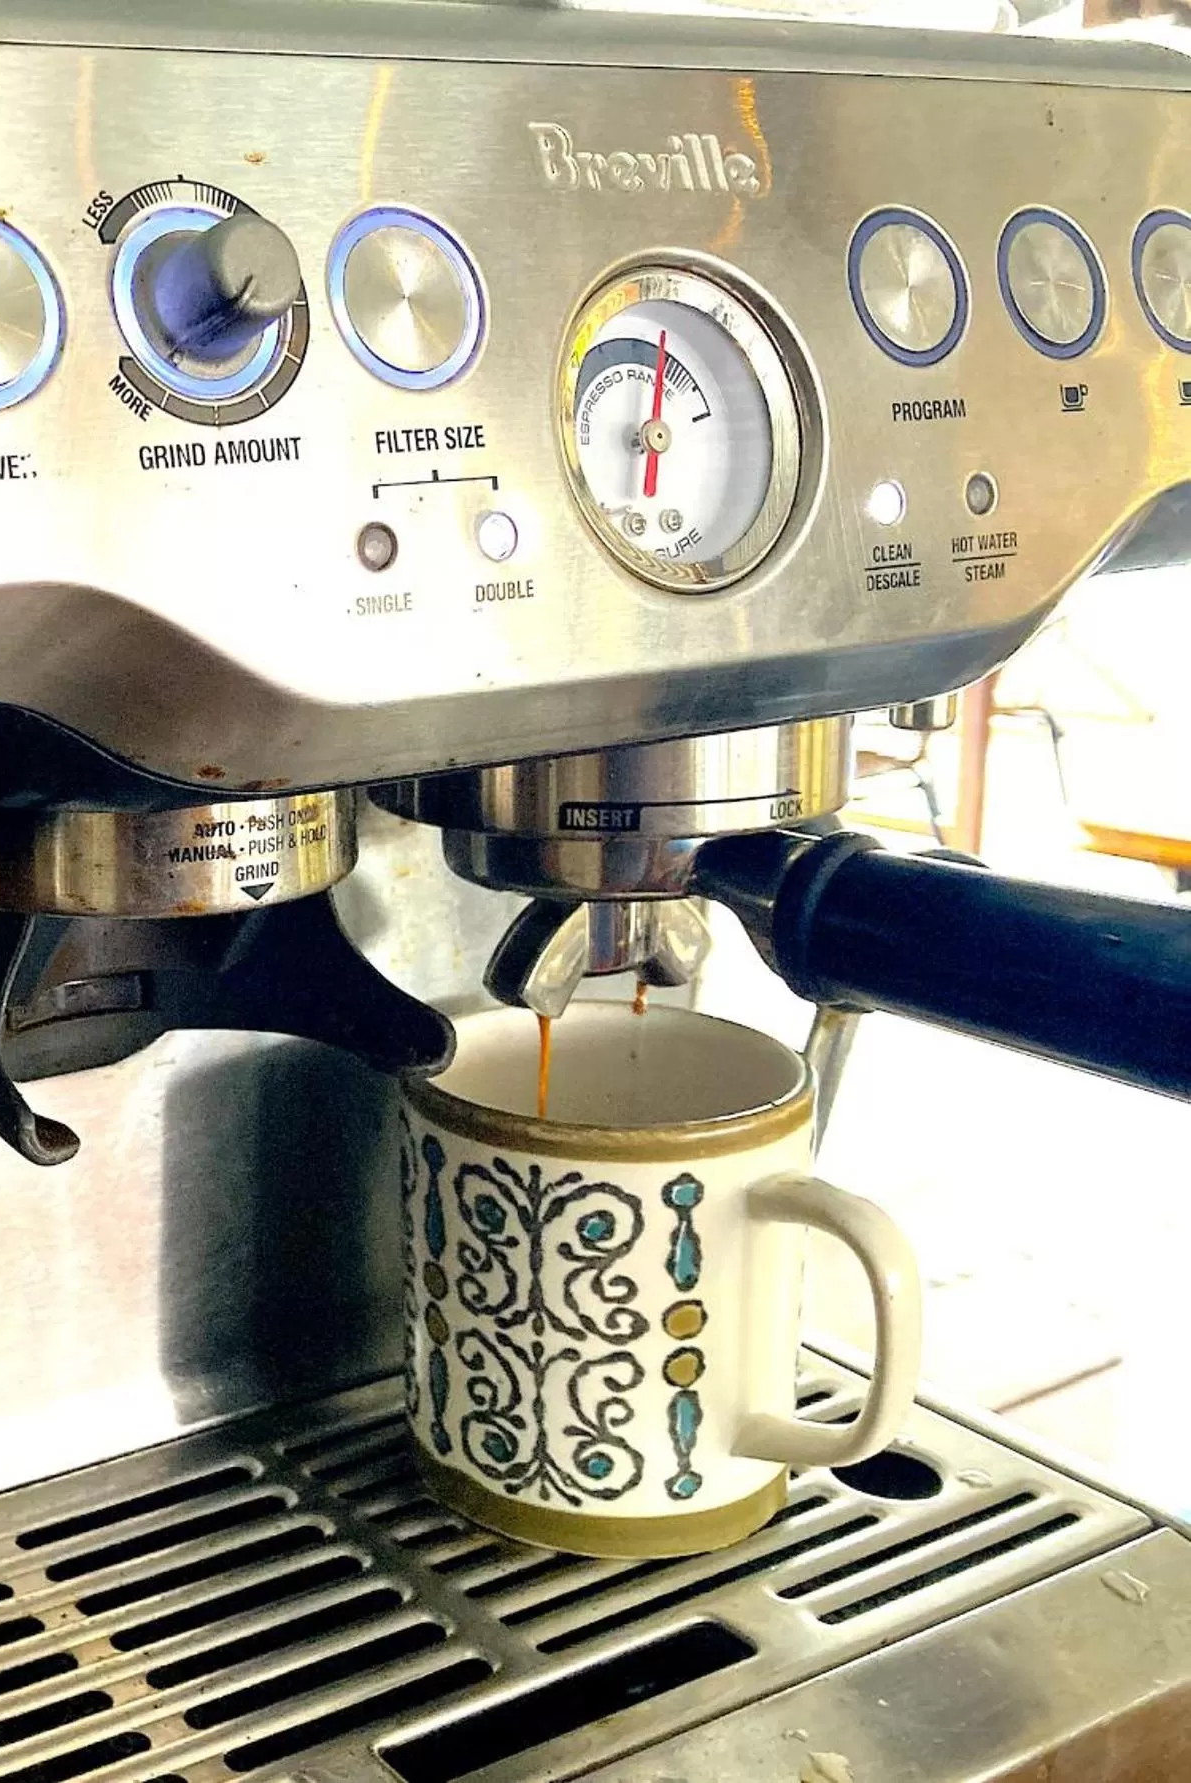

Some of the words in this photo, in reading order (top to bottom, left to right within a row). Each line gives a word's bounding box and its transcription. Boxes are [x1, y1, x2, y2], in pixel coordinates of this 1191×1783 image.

[528, 122, 761, 193] Breville
[82, 190, 114, 229] LESS
[109, 374, 153, 422] MORE
[580, 370, 624, 446] ESPRESSO
[892, 399, 967, 422] PROGRAM
[375, 428, 439, 454] FILTER
[444, 425, 485, 450] SIZE
[139, 443, 206, 470] GRIND
[214, 437, 301, 465] AMOUNT
[872, 543, 913, 562] CLEAN
[951, 536, 974, 554] HOT
[978, 531, 1018, 550] WATER
[866, 569, 921, 592] DESCALE
[965, 562, 1006, 583] STEAM
[476, 580, 534, 602] DOUBLE
[356, 593, 413, 616] SINGLE
[566, 808, 635, 828] INSERT
[770, 799, 804, 821] LOCK
[193, 820, 235, 839] AUTO
[248, 814, 285, 833] PUSH
[168, 843, 237, 863] MANUAL
[248, 836, 285, 857] PUSH
[288, 832, 298, 849] &
[301, 823, 327, 847] HOLD
[235, 861, 279, 882] GRIND
